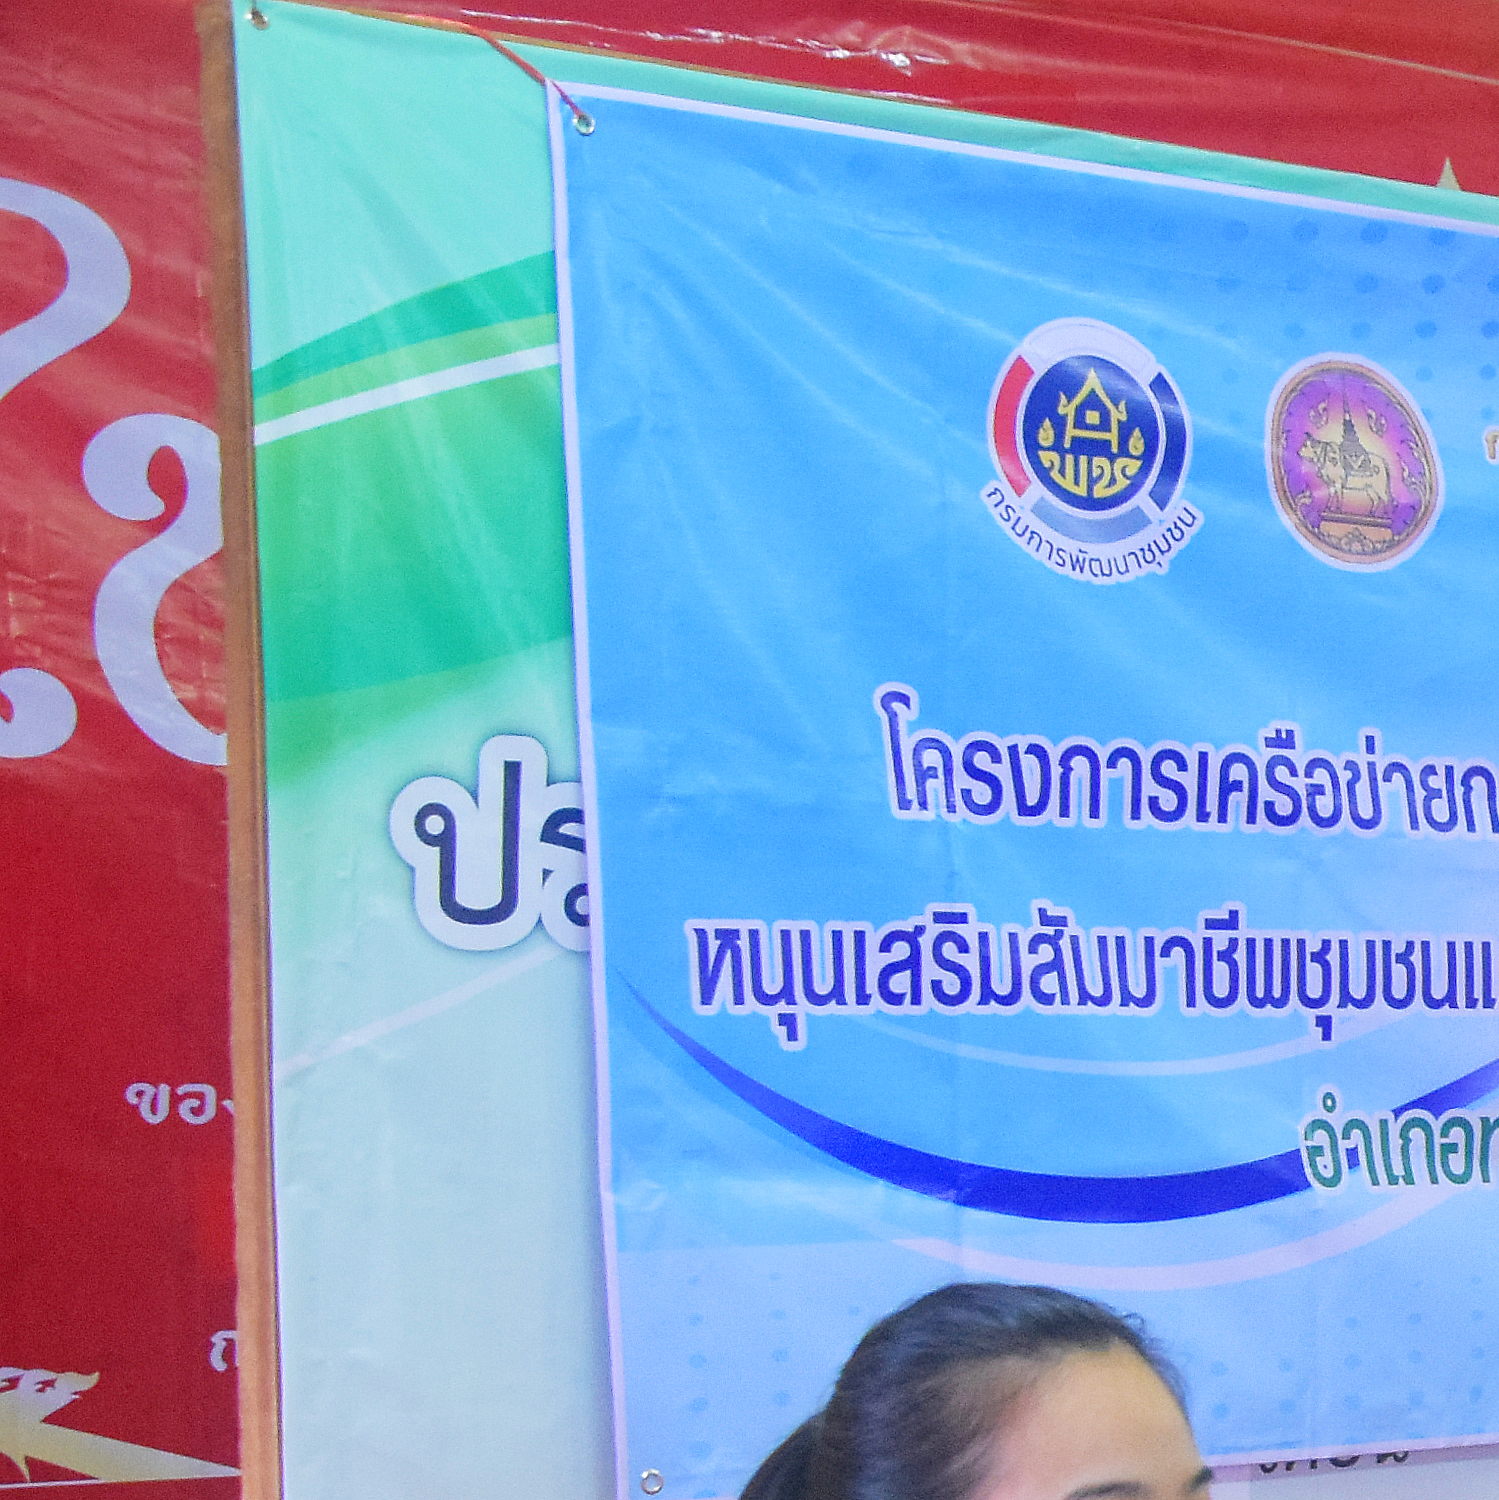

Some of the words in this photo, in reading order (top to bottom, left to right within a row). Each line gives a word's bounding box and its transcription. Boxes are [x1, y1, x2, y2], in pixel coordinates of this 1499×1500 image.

[985, 487, 1198, 578] กรมการพัฒนาชุมชน
[125, 1082, 235, 1125] ขอ
